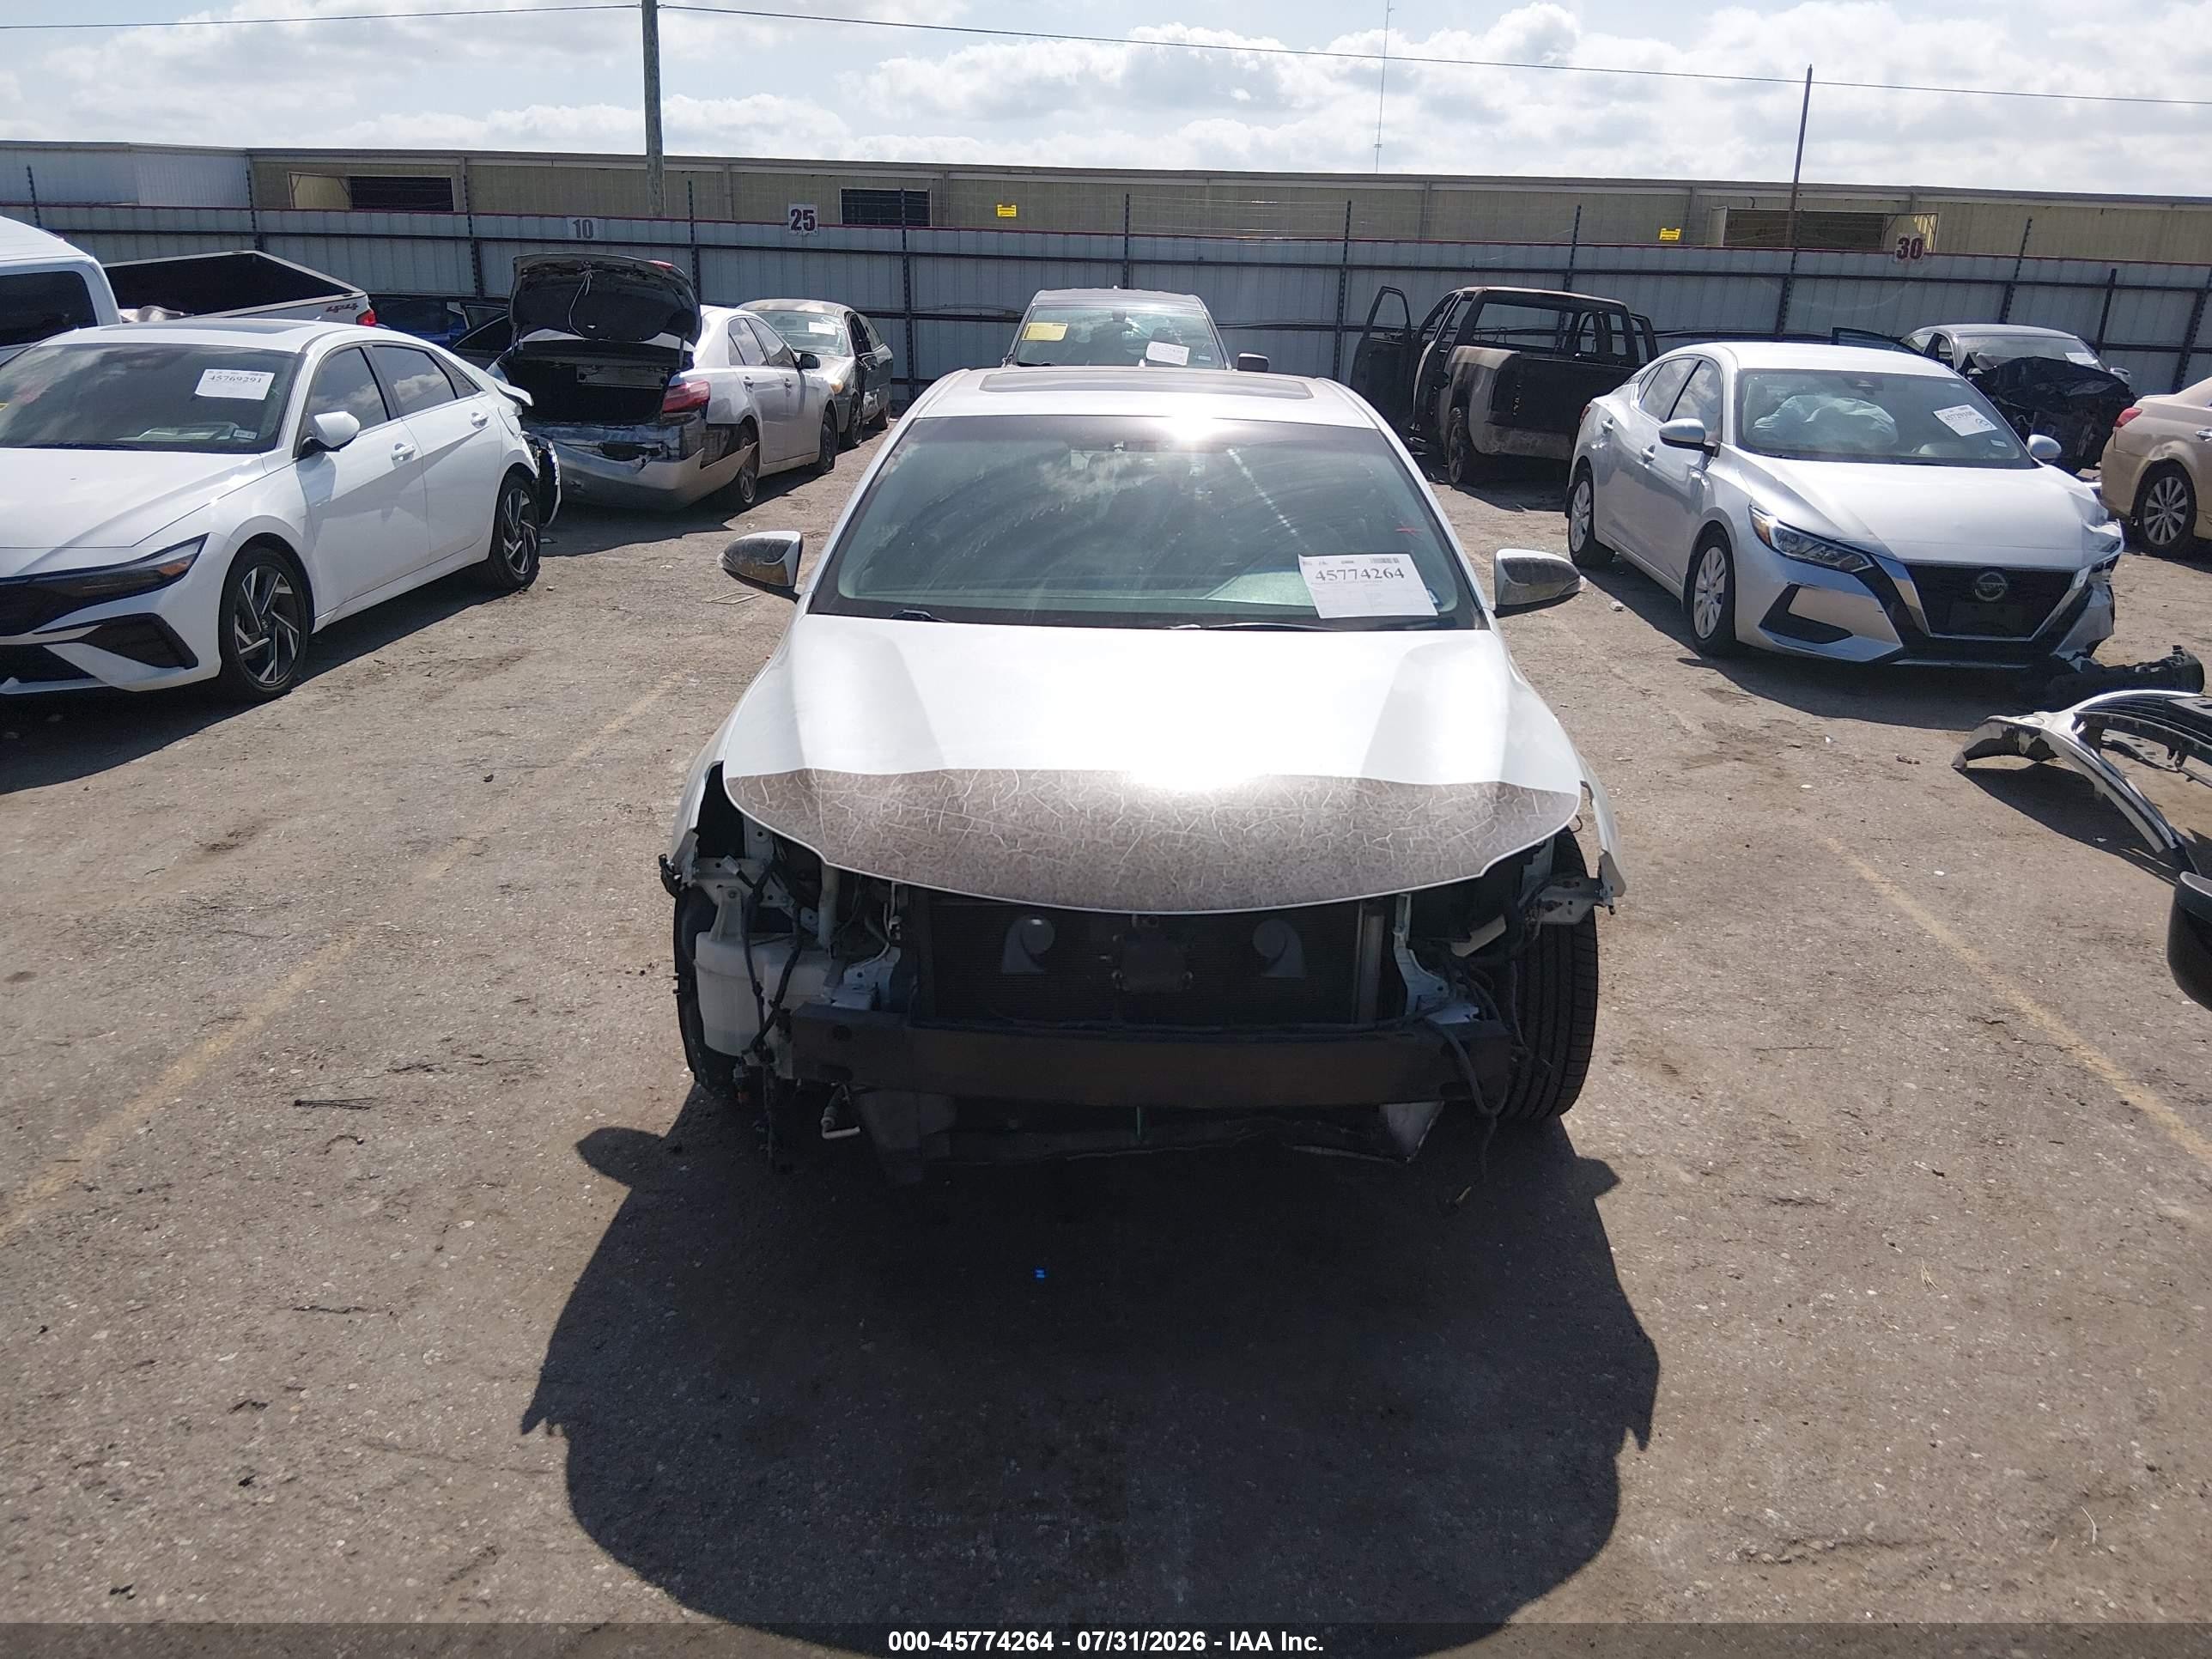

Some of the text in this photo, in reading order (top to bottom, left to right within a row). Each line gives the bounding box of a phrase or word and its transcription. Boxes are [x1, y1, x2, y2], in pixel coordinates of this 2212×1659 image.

[573, 219, 593, 239] 10
[790, 209, 815, 231] 25
[1896, 236, 1923, 259] 30
[1316, 567, 1405, 581] 45774264
